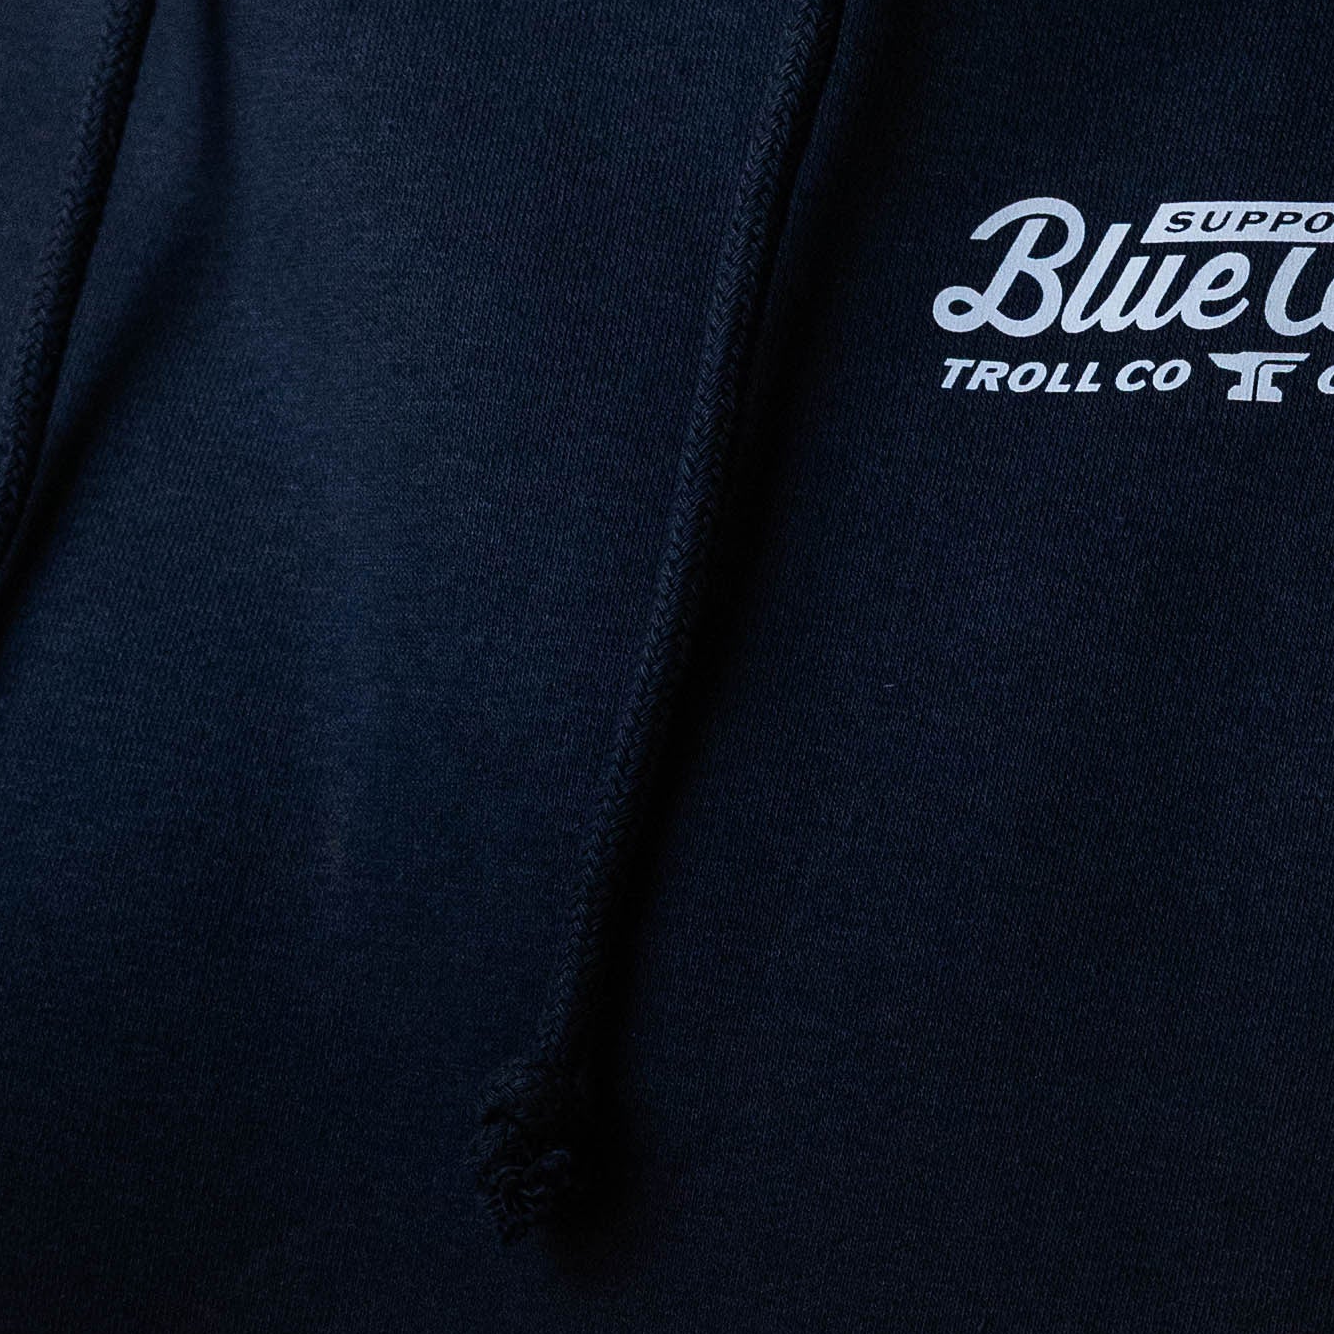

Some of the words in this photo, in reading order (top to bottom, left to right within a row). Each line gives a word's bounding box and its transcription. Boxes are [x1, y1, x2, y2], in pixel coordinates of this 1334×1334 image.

[933, 197, 1251, 338] Blue
[941, 357, 1102, 393] TROLL
[1114, 358, 1192, 392] CO
